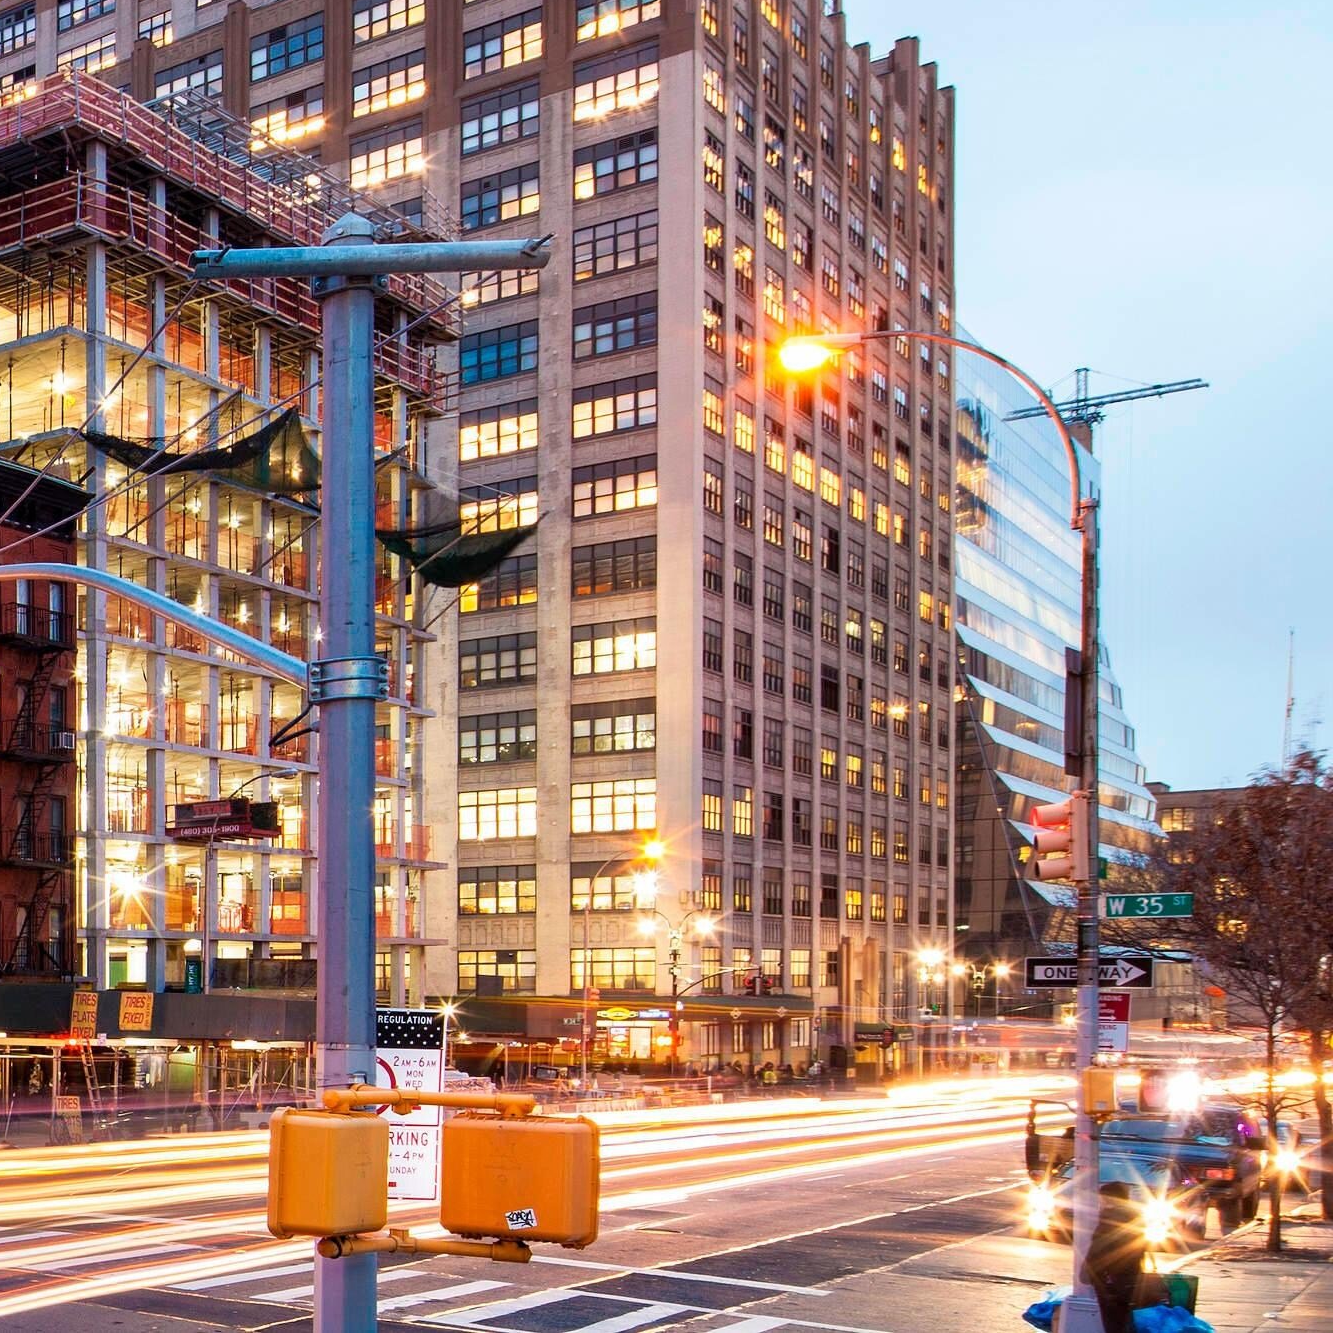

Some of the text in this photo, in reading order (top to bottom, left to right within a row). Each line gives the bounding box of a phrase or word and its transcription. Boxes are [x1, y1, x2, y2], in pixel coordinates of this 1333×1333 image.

[1109, 896, 1187, 915] W 35 ST
[1044, 966, 1134, 979] ONE WAY
[75, 993, 97, 1007] TIRES
[124, 996, 147, 1008] TIRES
[72, 1010, 96, 1023] FLATS
[122, 1012, 145, 1024] FIXED
[377, 1014, 433, 1025] REGULATION
[406, 1070, 424, 1078] MON
[405, 1079, 423, 1088] WED
[57, 1097, 78, 1110] TIRES
[388, 1131, 429, 1147] RKING
[389, 1166, 417, 1175] UNDAY
